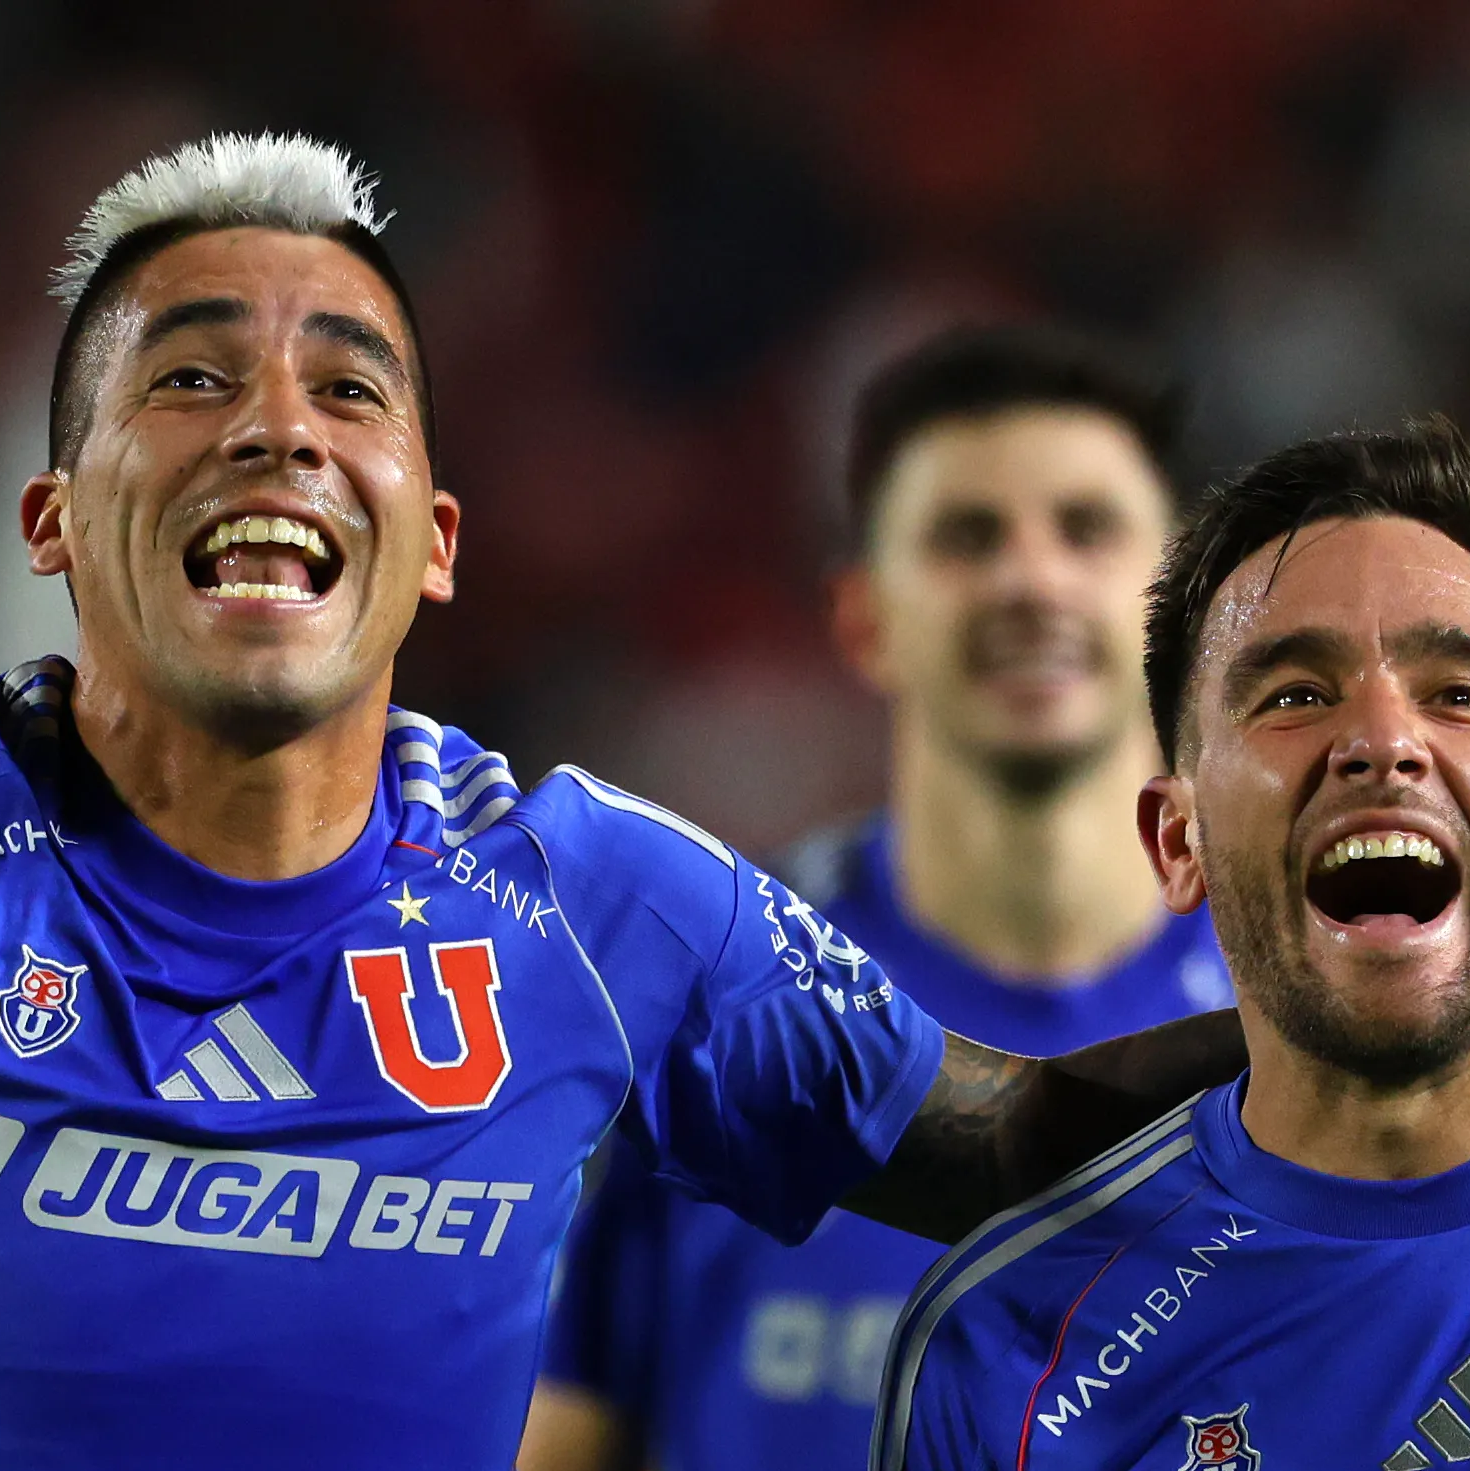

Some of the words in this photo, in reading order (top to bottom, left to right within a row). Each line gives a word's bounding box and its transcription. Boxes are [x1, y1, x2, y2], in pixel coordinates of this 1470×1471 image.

[15, 1003, 54, 1041] U
[342, 936, 514, 1114] U
[1036, 1213, 1258, 1438] MACHBANK
